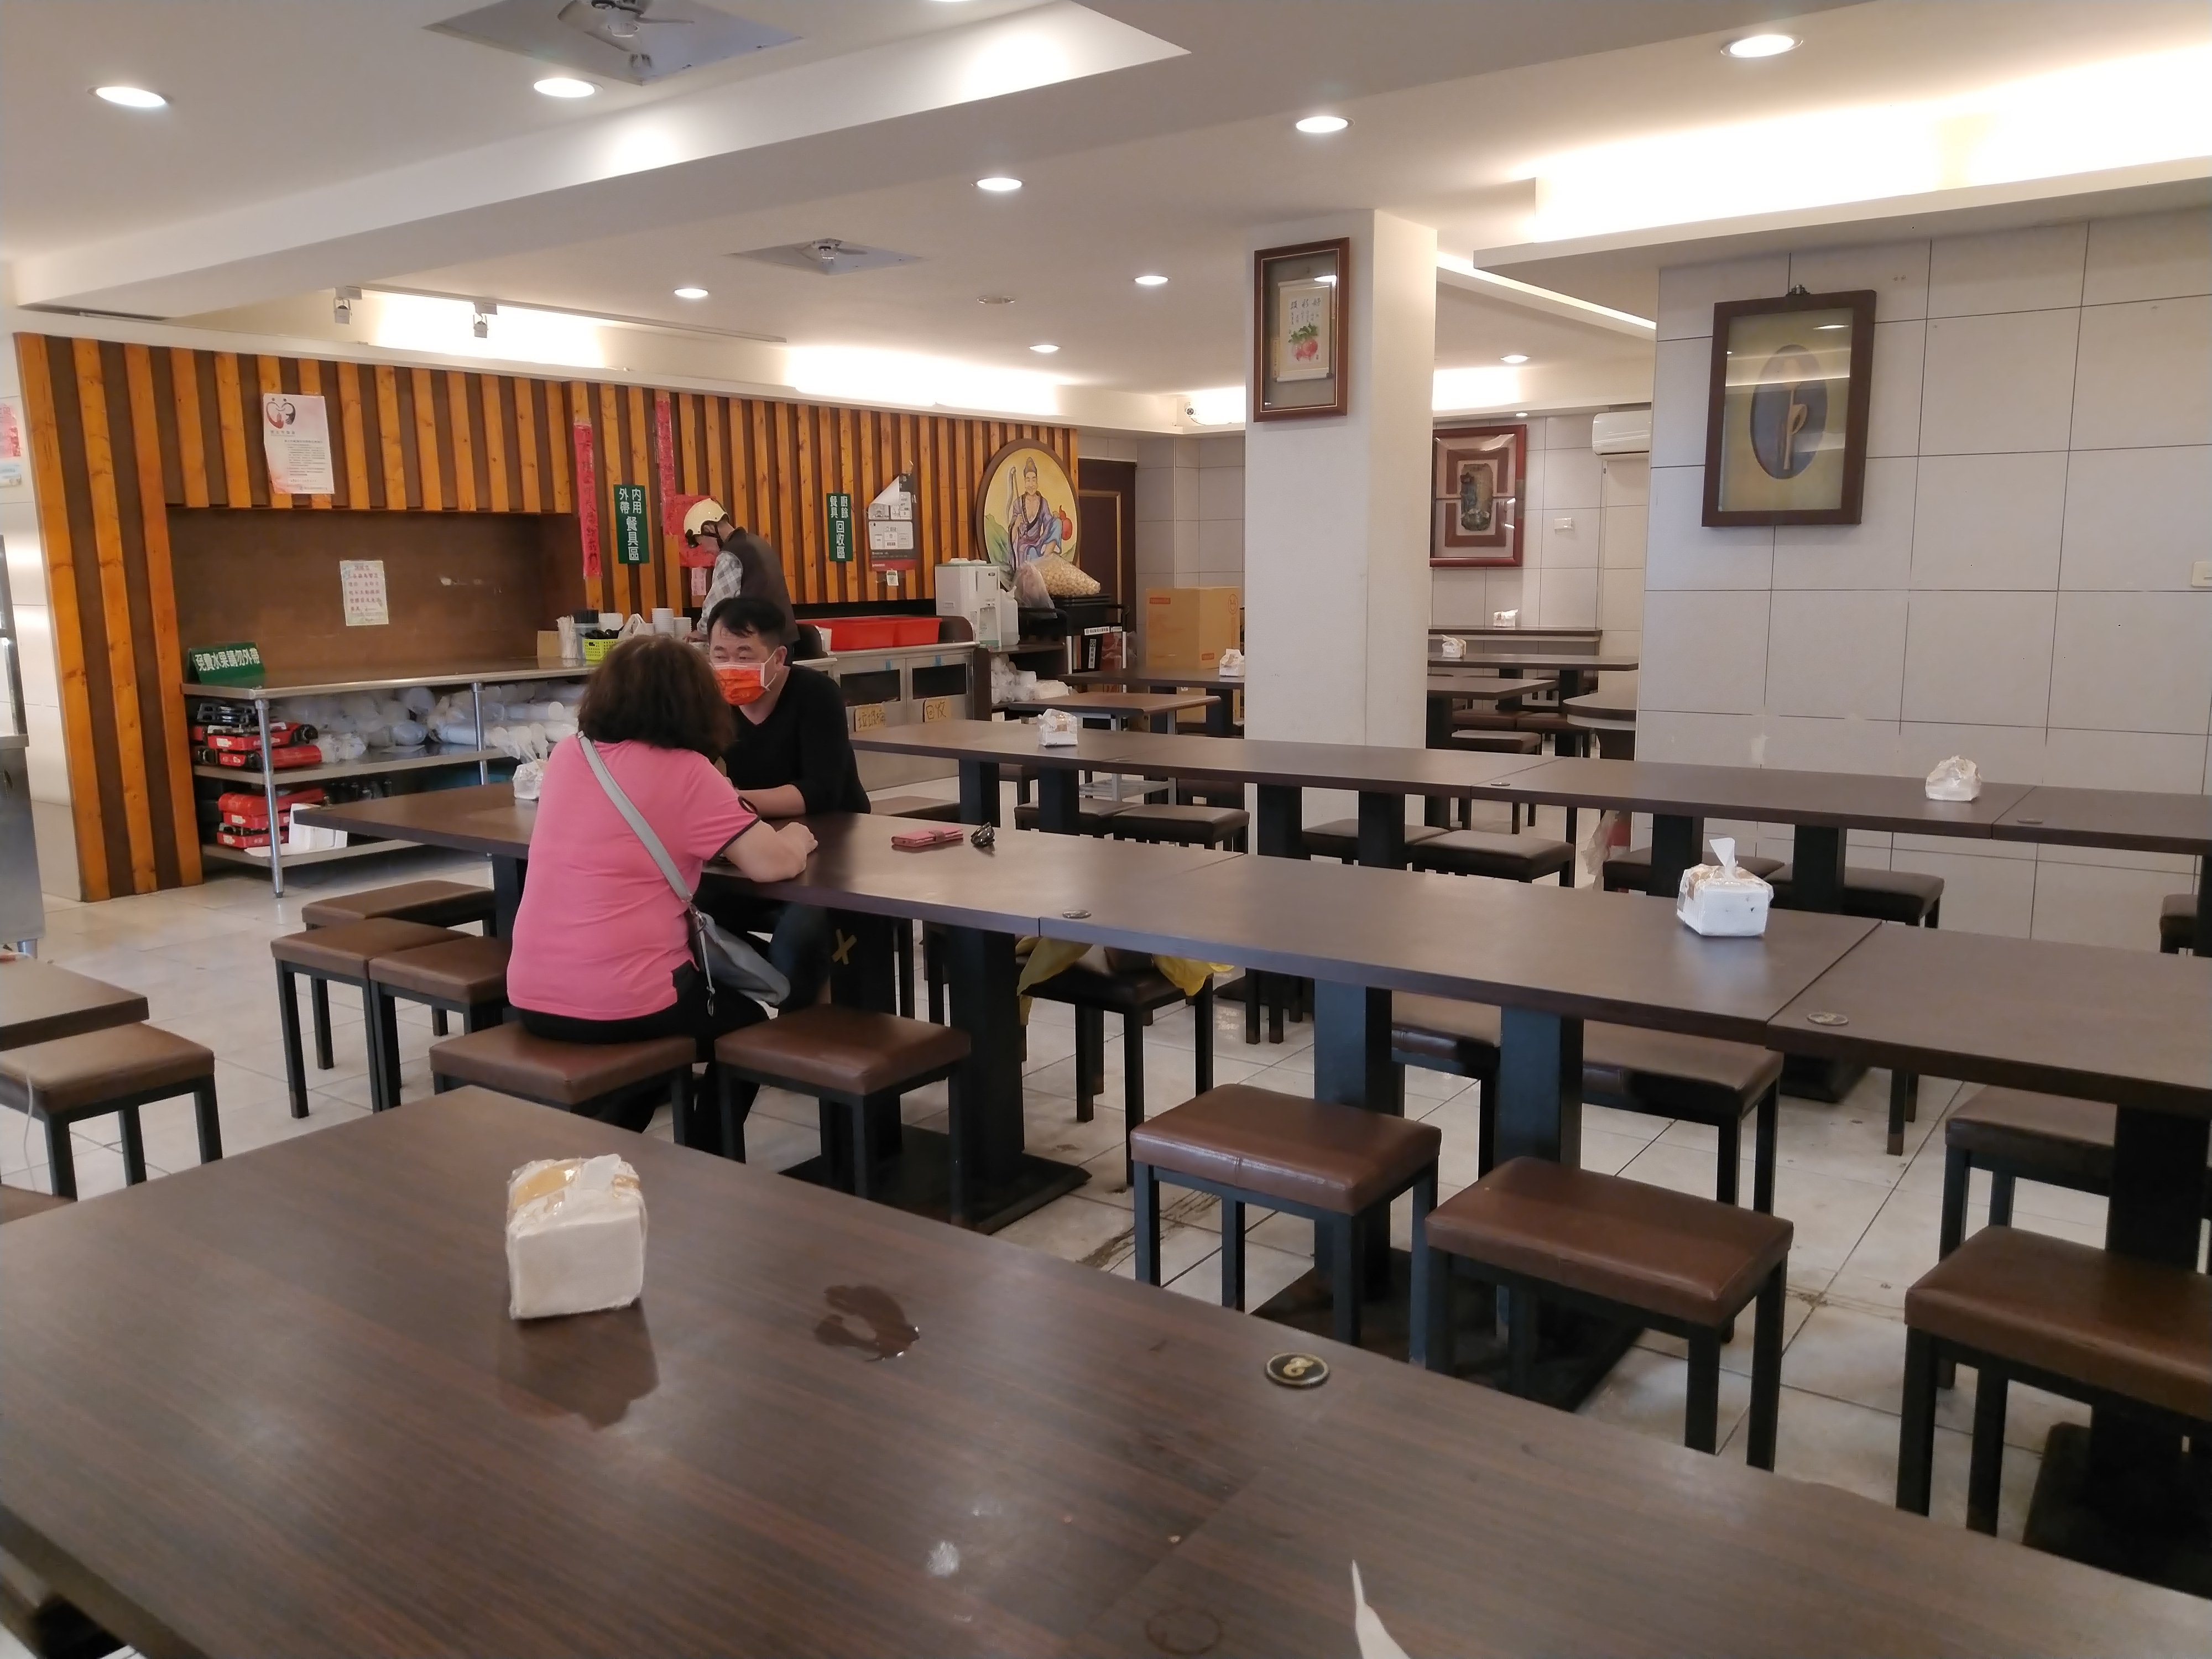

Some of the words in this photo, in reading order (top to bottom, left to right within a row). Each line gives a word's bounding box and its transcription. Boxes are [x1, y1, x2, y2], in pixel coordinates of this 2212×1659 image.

[619, 488, 629, 514] 外帶
[830, 495, 838, 519] 餐具
[626, 516, 639, 561] 餐具區
[836, 520, 845, 559] 回收區
[926, 701, 946, 720] 回收
